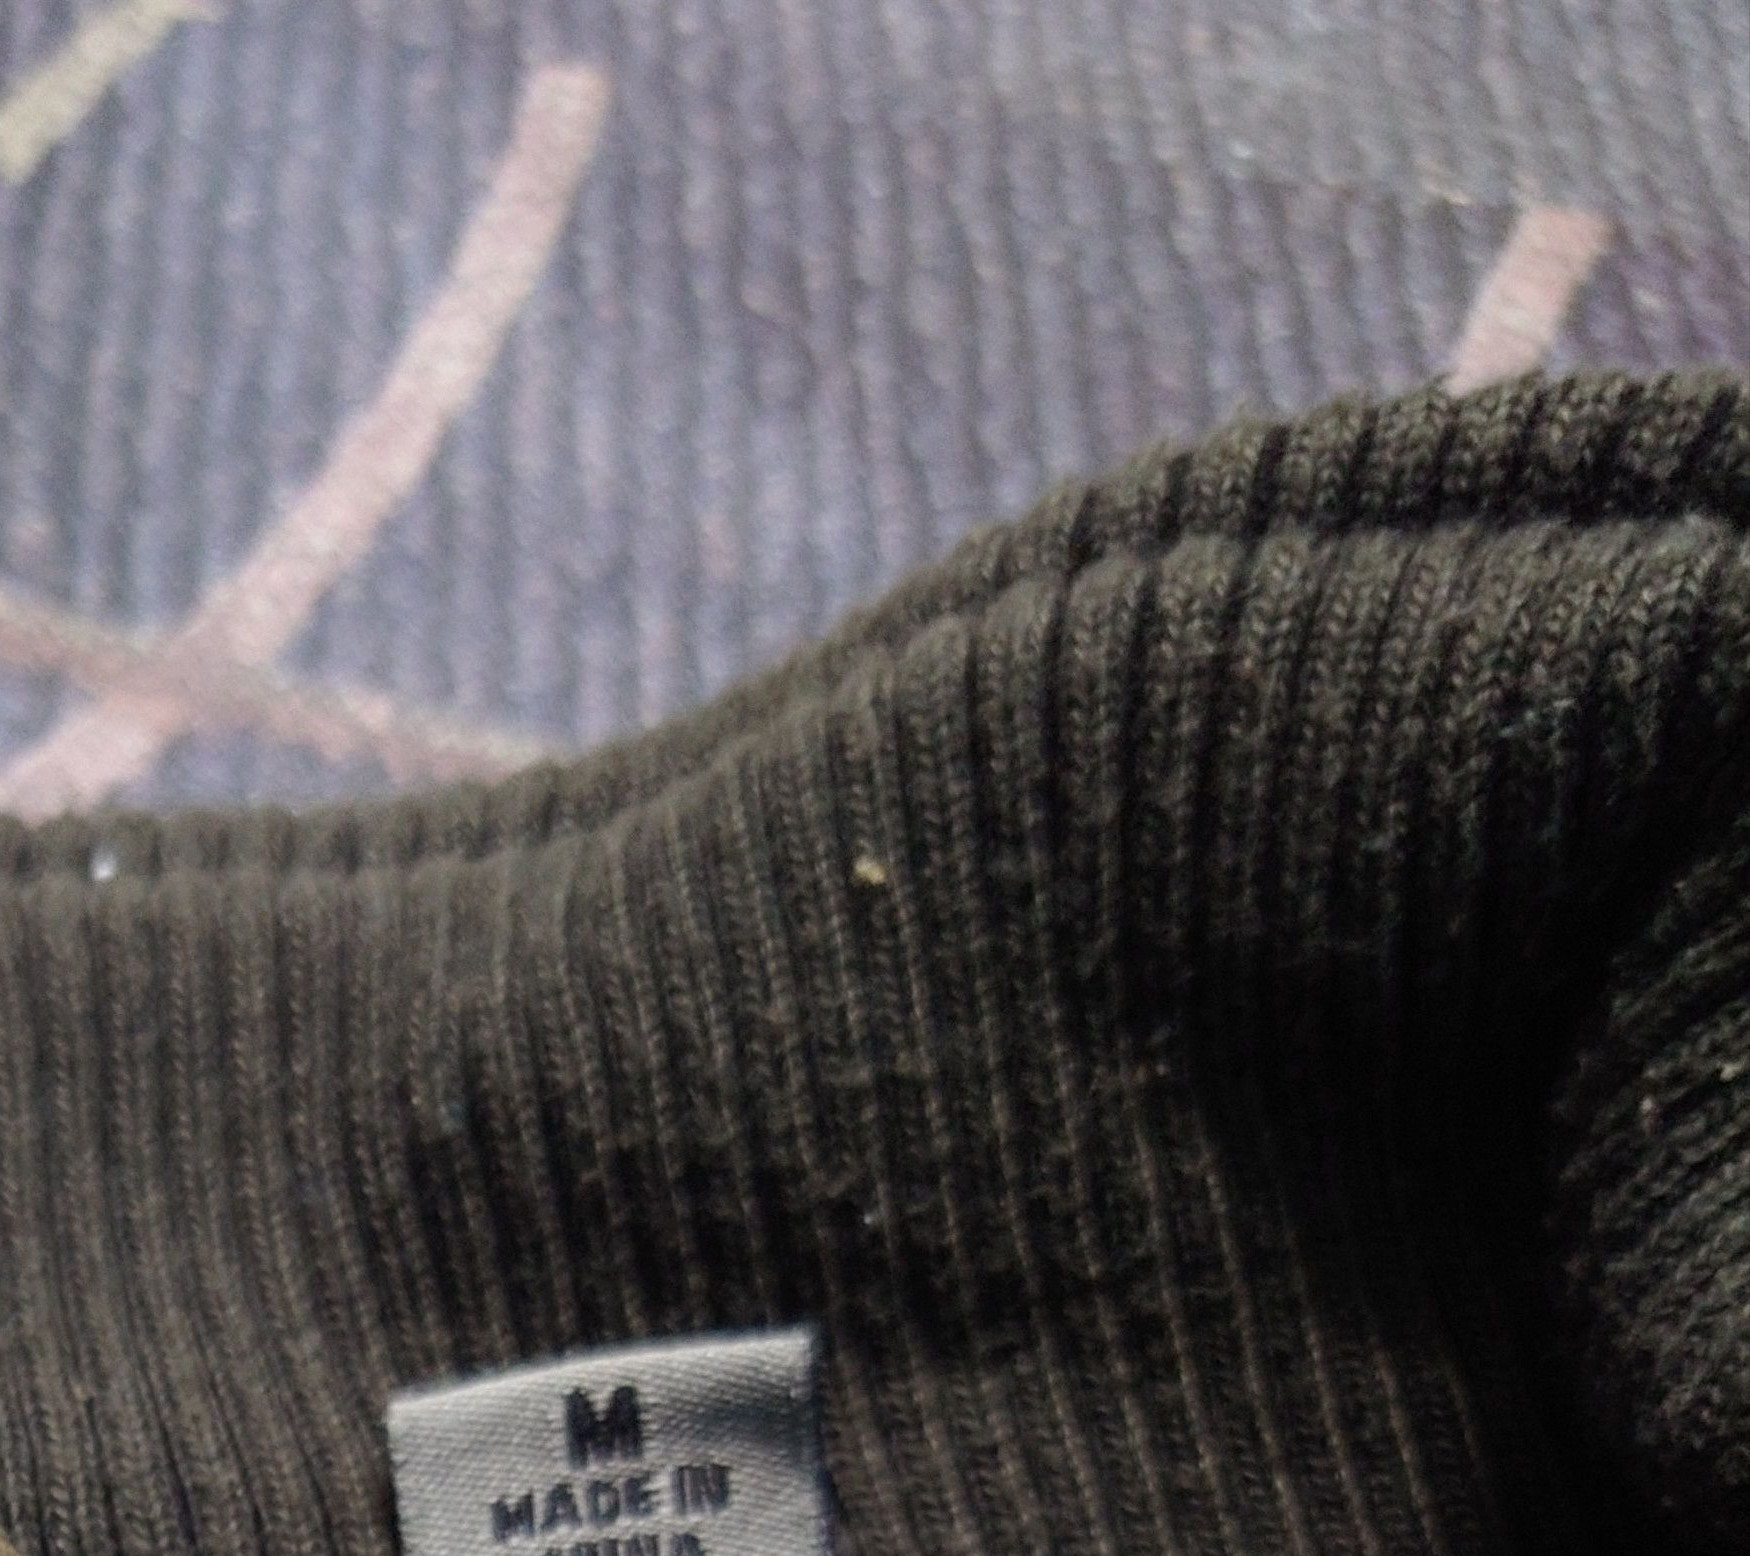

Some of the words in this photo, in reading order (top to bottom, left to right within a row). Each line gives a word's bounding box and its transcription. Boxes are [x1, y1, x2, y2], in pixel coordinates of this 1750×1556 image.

[564, 1385, 641, 1468] M
[490, 1476, 652, 1542] MADE
[671, 1463, 730, 1515] IN
